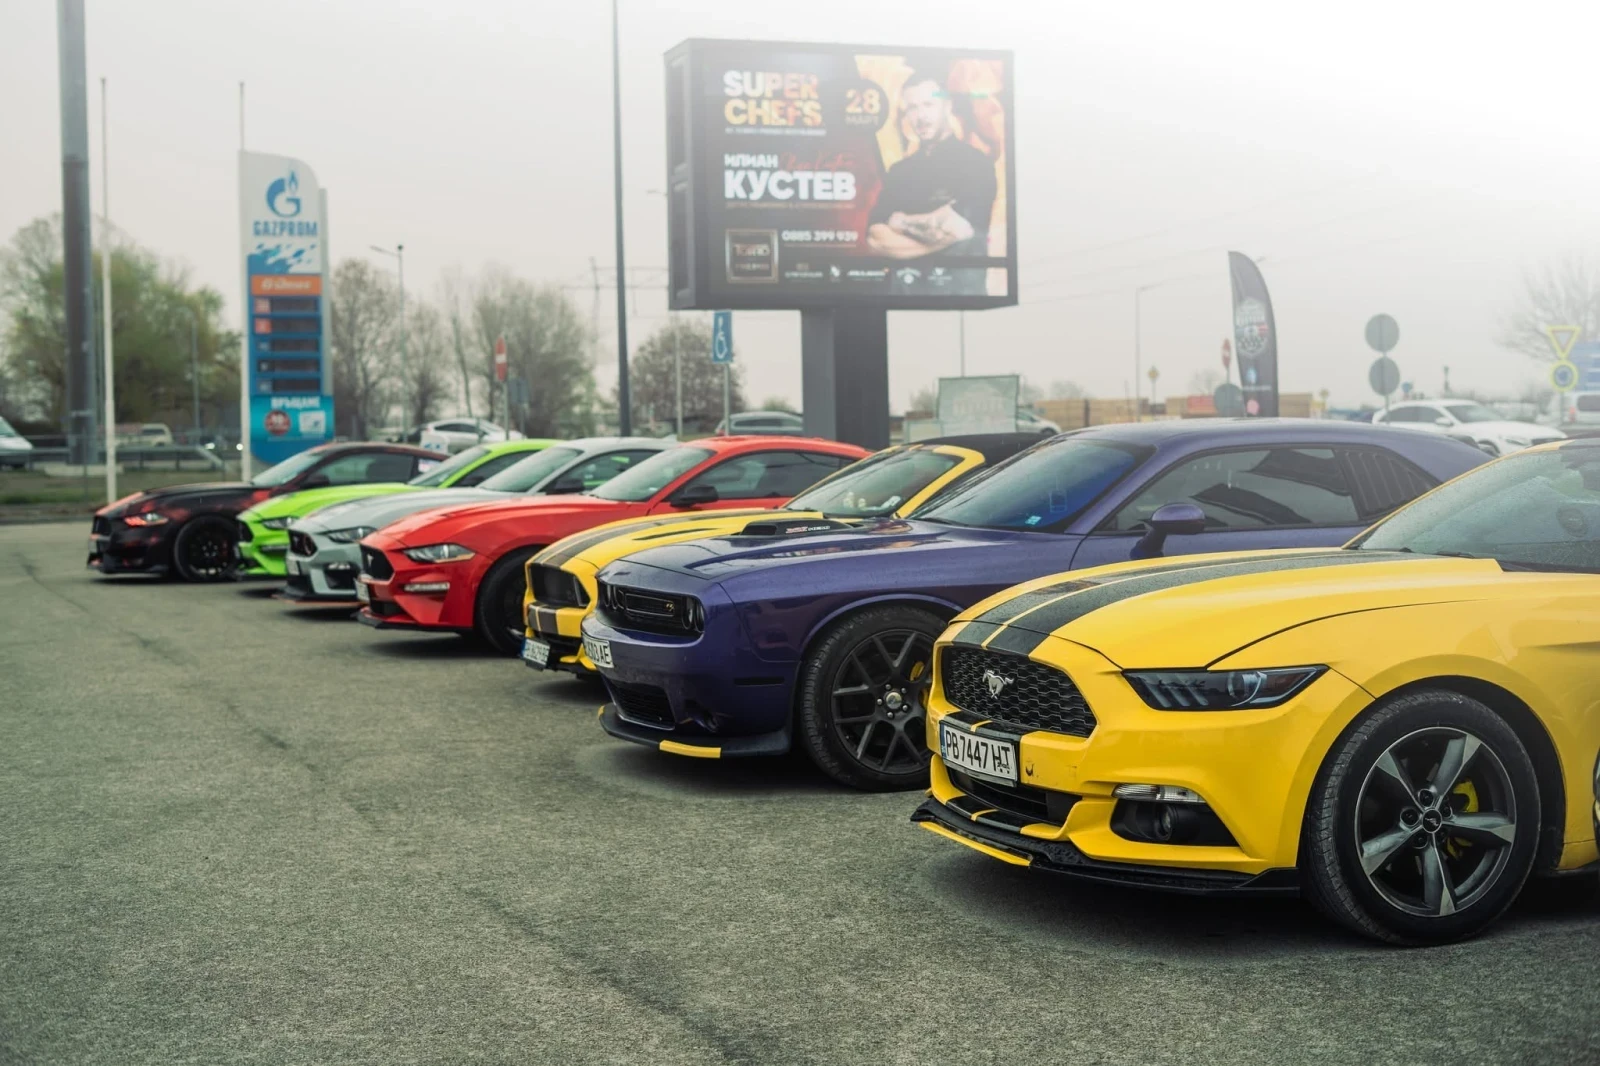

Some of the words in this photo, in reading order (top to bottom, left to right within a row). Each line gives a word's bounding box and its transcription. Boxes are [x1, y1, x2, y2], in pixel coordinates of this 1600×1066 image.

[723, 70, 819, 99] SUPER
[724, 99, 822, 126] CHEFS
[845, 88, 880, 114] 28
[724, 169, 856, 200] КУСТЕВ
[253, 220, 318, 237] GAZPROM
